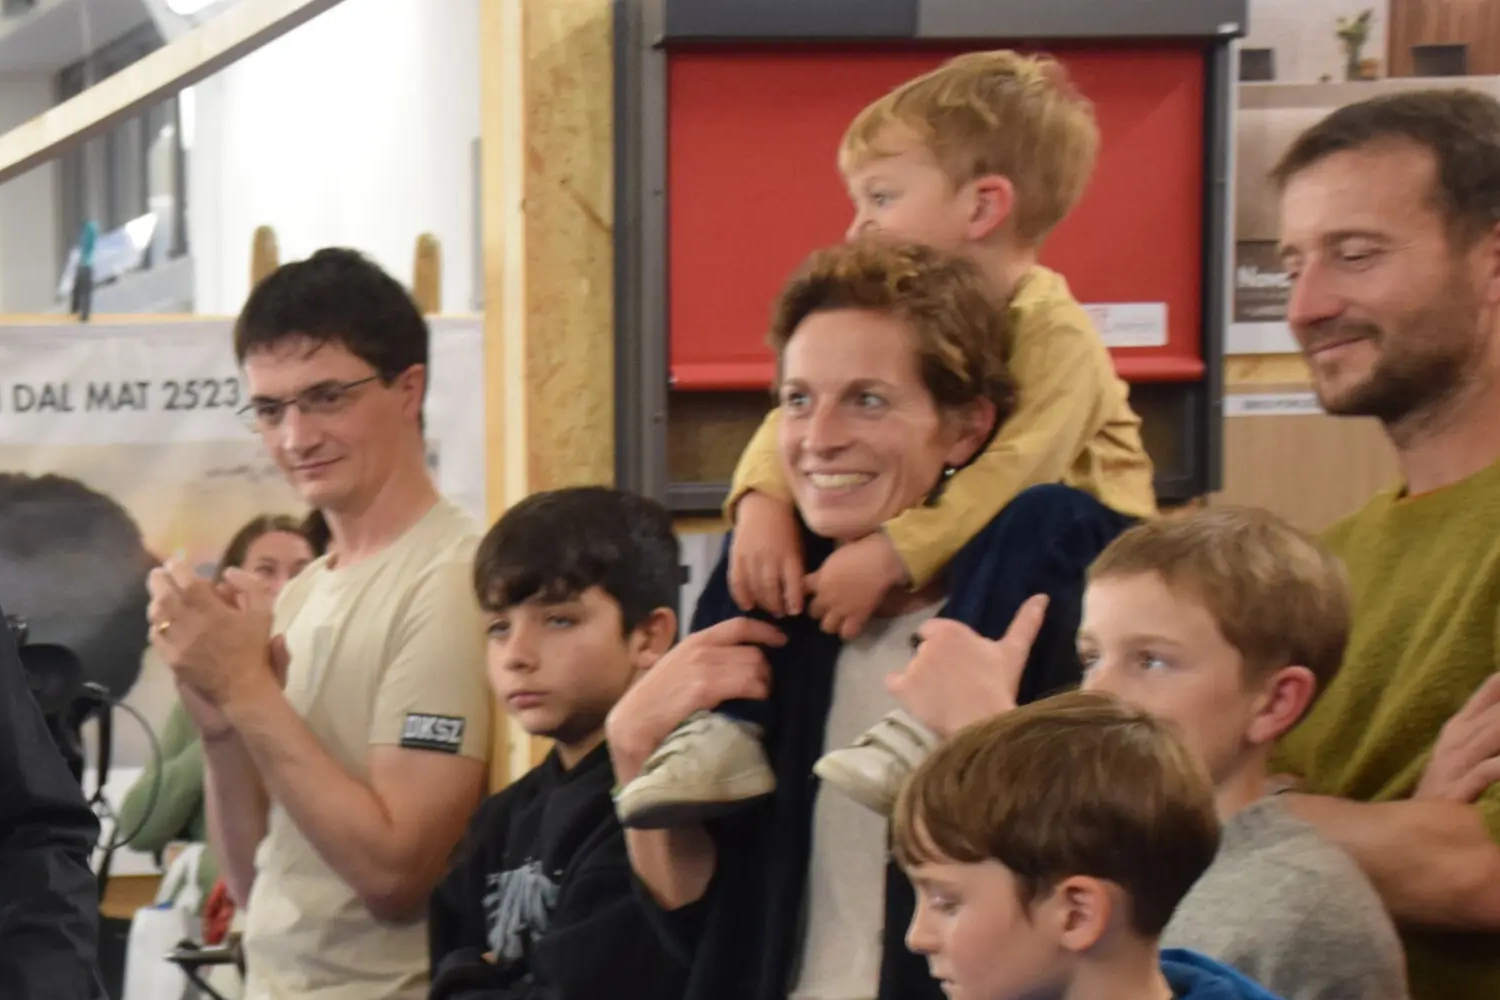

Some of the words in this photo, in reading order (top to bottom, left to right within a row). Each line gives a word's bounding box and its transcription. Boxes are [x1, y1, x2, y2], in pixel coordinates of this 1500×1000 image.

[13, 383, 73, 413] DAL
[86, 381, 151, 412] MAT
[161, 377, 241, 411] 2523
